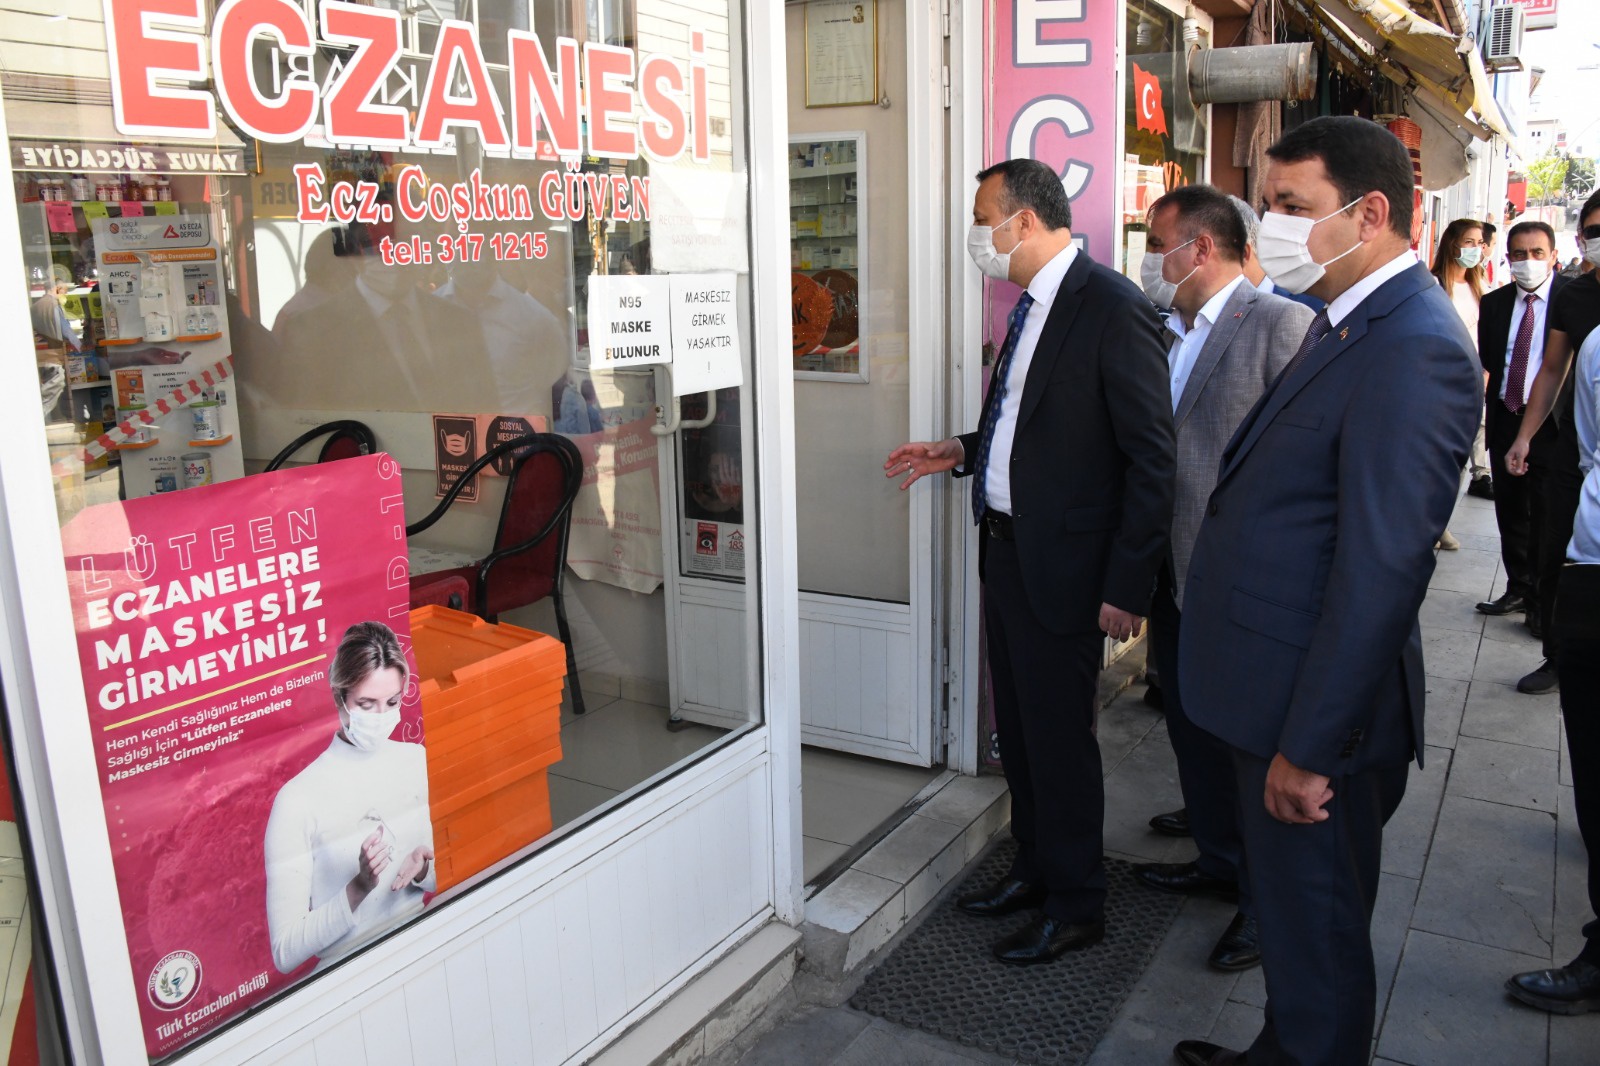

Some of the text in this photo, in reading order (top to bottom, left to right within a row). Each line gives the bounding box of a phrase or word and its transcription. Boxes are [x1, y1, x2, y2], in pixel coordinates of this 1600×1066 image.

[103, 0, 712, 164] ECZANESİ
[293, 160, 650, 231] Ecz. Coşkun GÜVEN
[380, 232, 548, 265] tel: 317 1215
[109, 270, 130, 278] AHCC
[618, 296, 643, 309] N95
[691, 312, 726, 327] GİRMEK
[611, 320, 652, 334] MASKE
[686, 335, 732, 350] YASAKTIR
[605, 344, 661, 360] BULUNUR
[499, 421, 524, 431] SOSYAL
[441, 463, 470, 472] MASKES
[80, 506, 319, 594] LÜTFEN
[728, 540, 744, 551] 183
[86, 545, 321, 629] ECZANELERE
[94, 577, 324, 671] MASKESİZ
[97, 622, 309, 711] GİRMEYİNİZ
[105, 669, 325, 752] Hem Kendi Sağlığınız Hem de Bizlerin
[107, 698, 292, 769] Sağlığı İçin "Lütfen Eczanelere
[107, 728, 244, 784] Maskesiz Girmeyiniz"
[155, 971, 270, 1041] Türk Eczacıları Birliği
